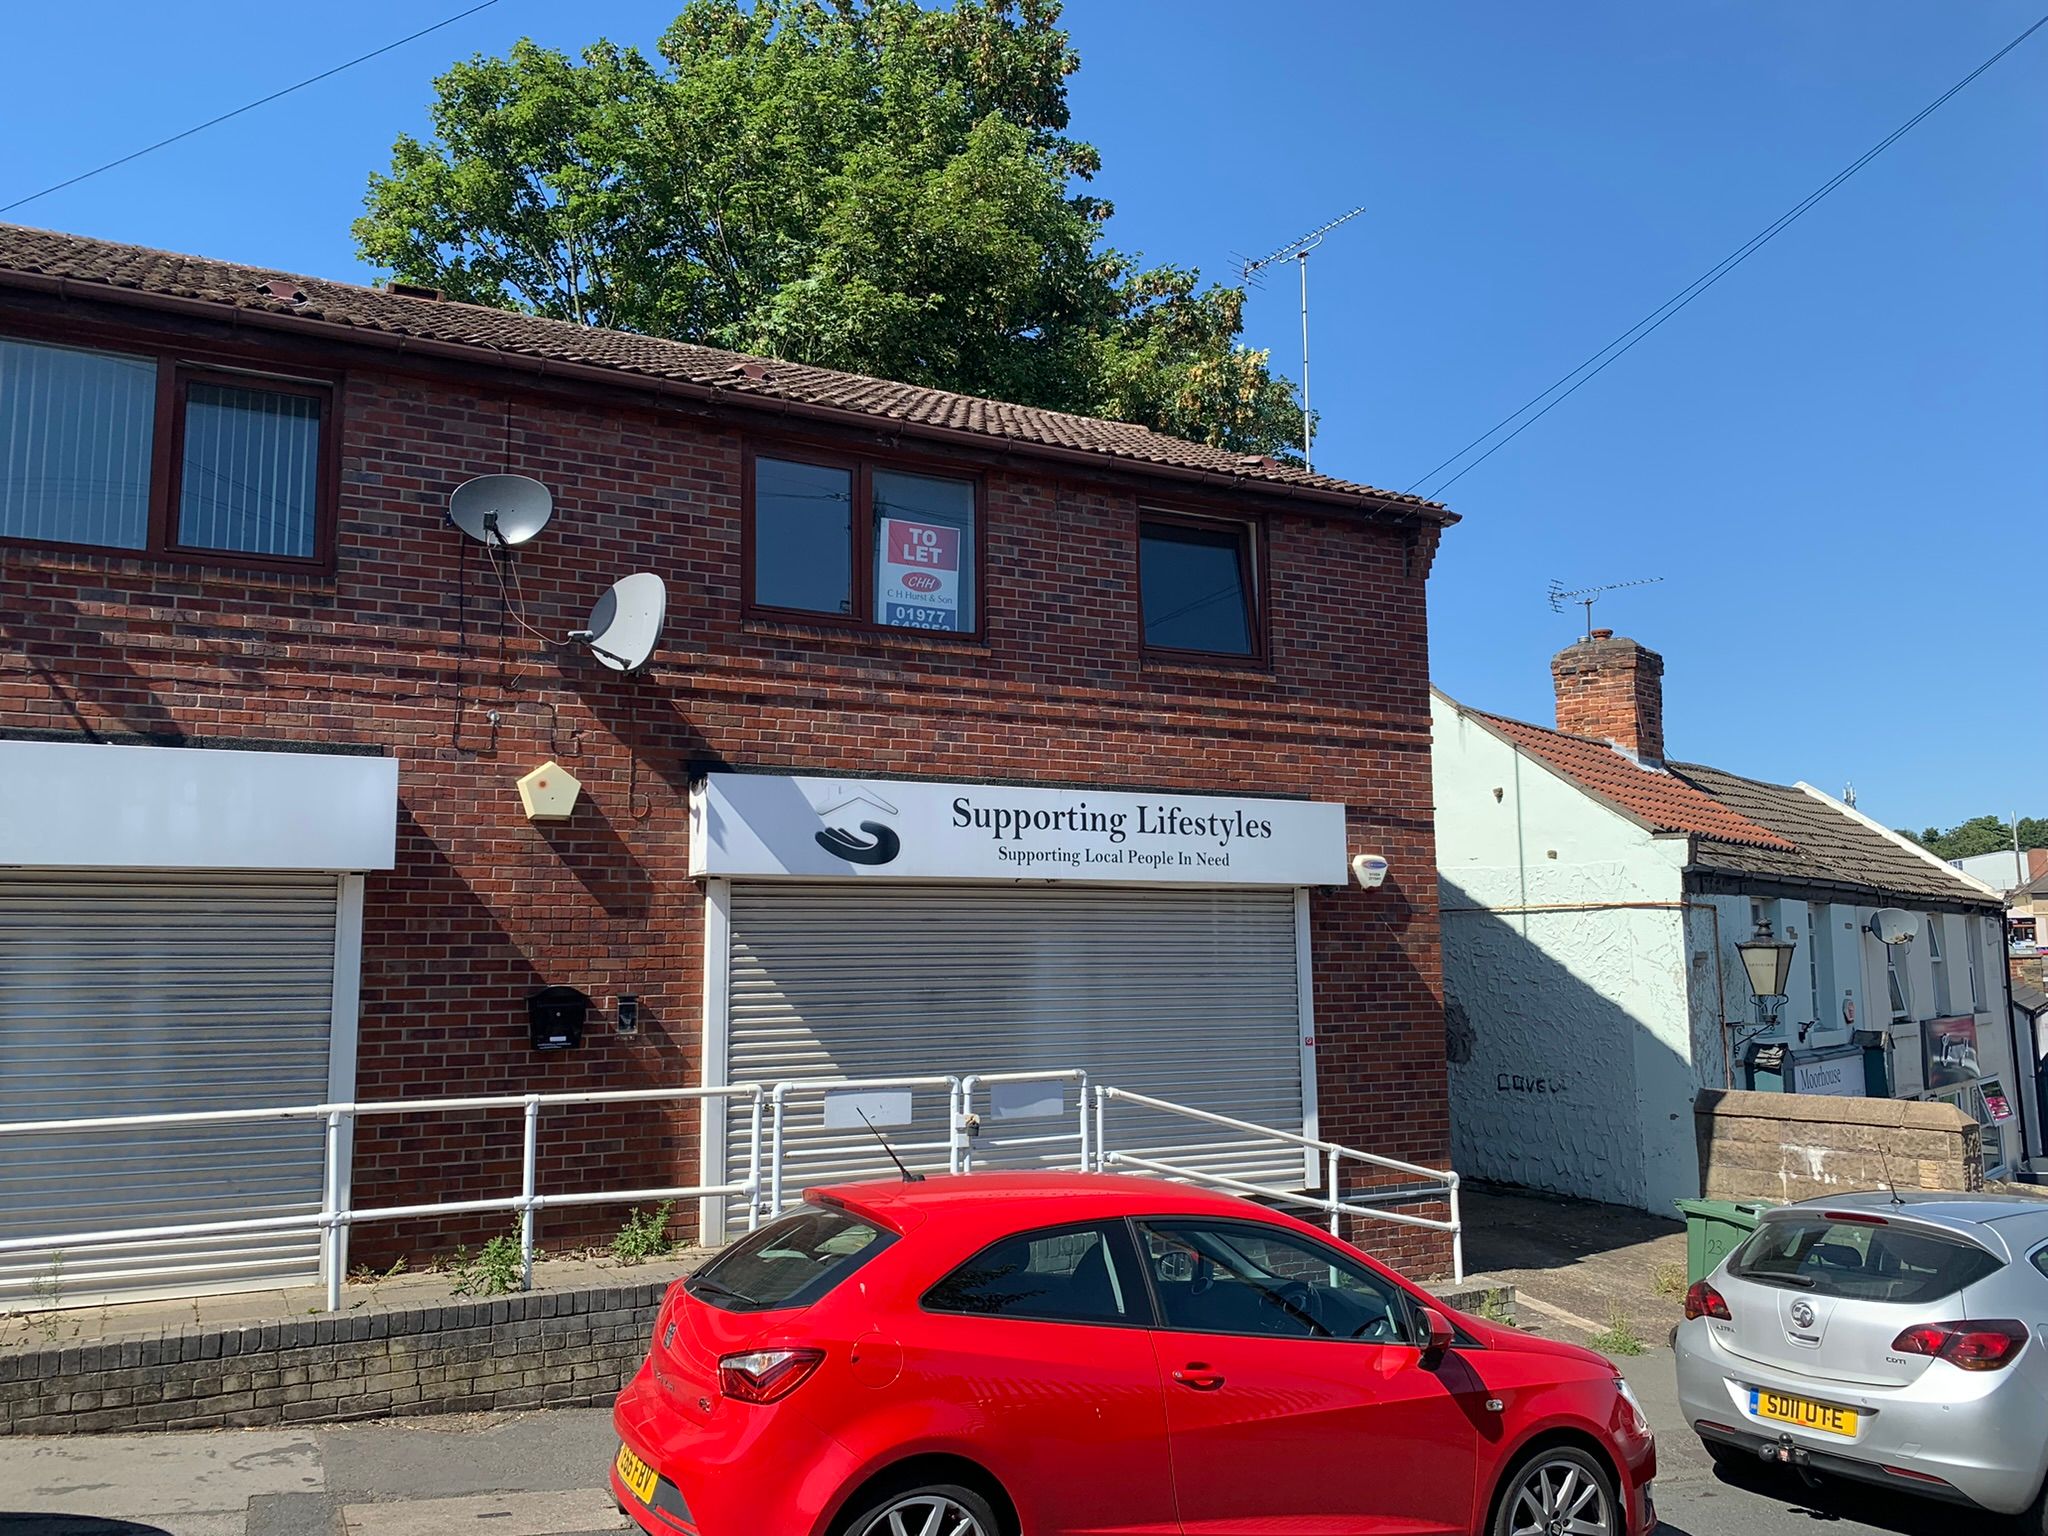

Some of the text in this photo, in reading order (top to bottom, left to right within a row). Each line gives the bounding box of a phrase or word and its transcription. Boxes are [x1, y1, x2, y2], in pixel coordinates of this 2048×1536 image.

[908, 528, 937, 547] TO
[903, 544, 942, 564] LET
[908, 576, 936, 589] CHH
[887, 589, 953, 605] C H Hurst & Son
[896, 606, 946, 623] 01977
[952, 797, 1272, 846] Supporting Lifestyles
[998, 846, 1230, 869] Supporting Local People In Need
[1800, 1064, 1841, 1091] Moorhouse
[1767, 1394, 1844, 1429] SD11 UTE
